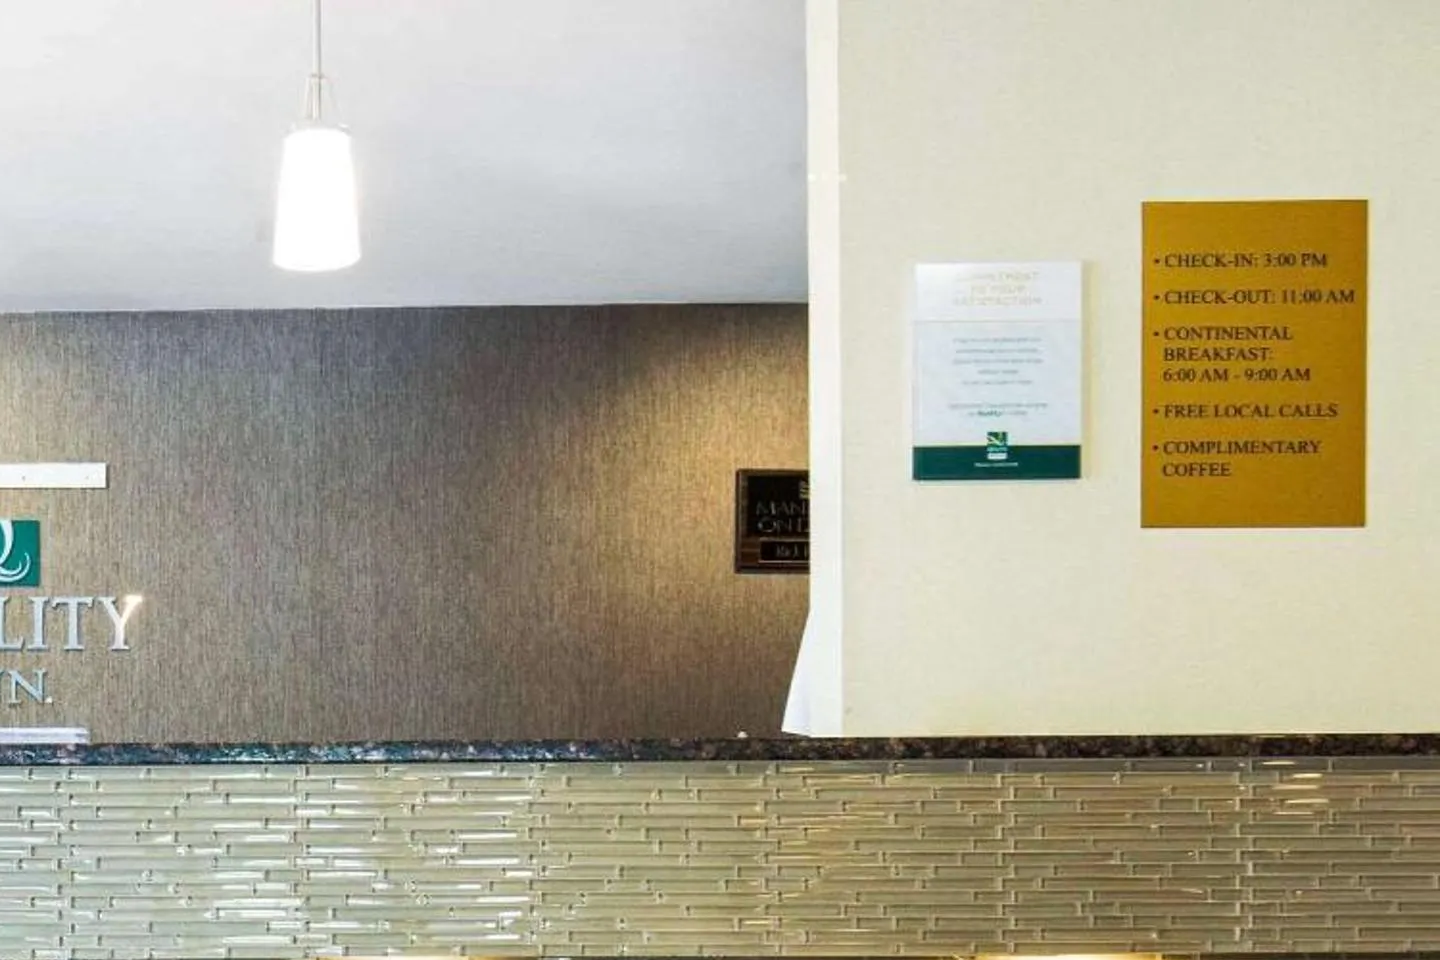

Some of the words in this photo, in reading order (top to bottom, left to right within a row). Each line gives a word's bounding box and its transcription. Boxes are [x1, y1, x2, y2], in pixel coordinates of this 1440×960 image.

[1164, 253, 1260, 268] CHECK-IN:
[1263, 253, 1297, 267] 3:00
[1301, 253, 1328, 267] PM
[1164, 289, 1276, 305] CHECK-OUT:
[1281, 289, 1323, 304] 11:00
[1326, 289, 1356, 304] AM
[1163, 326, 1293, 341] CONTINENTAL
[1163, 347, 1274, 362] BREAKFAST:
[1162, 368, 1197, 382] 6:00
[1199, 368, 1229, 382] AM
[1244, 368, 1278, 382] 9:00
[1281, 368, 1311, 382] AM
[1163, 404, 1209, 418] FREE
[1213, 404, 1274, 418] LOCAL
[1278, 404, 1339, 418] CALLS
[1162, 440, 1322, 456] COMPLIMENTARY
[1162, 462, 1232, 477] COFFEE
